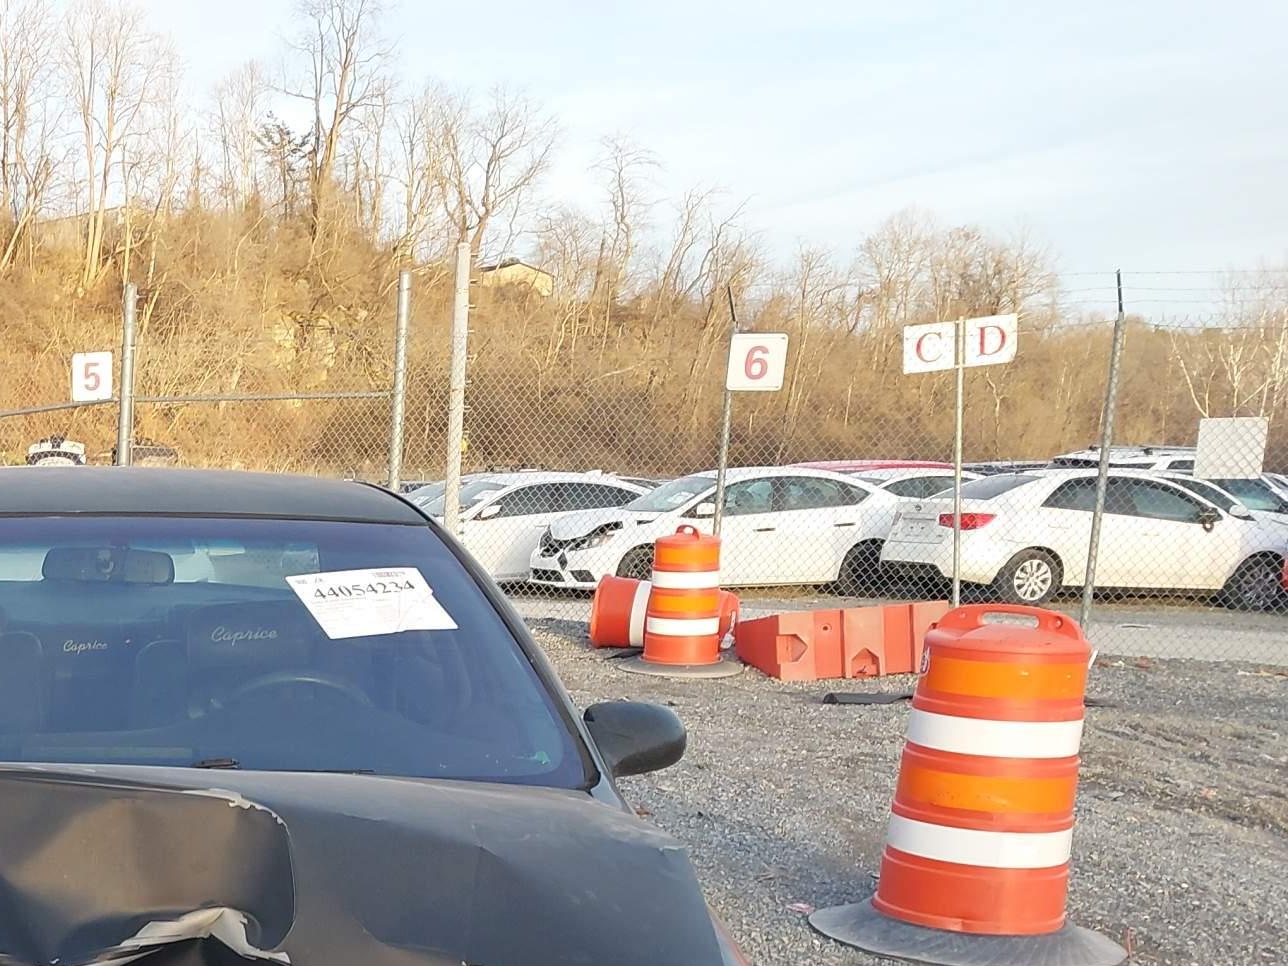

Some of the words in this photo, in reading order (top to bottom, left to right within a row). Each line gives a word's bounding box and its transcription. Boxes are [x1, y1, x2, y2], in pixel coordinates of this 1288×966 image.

[915, 331, 943, 363] C
[976, 325, 1007, 357] D
[744, 345, 770, 380] 6
[84, 362, 101, 391] 5
[314, 580, 416, 600] 44054234
[63, 640, 108, 654] Caprice
[211, 626, 278, 646] Caprice
